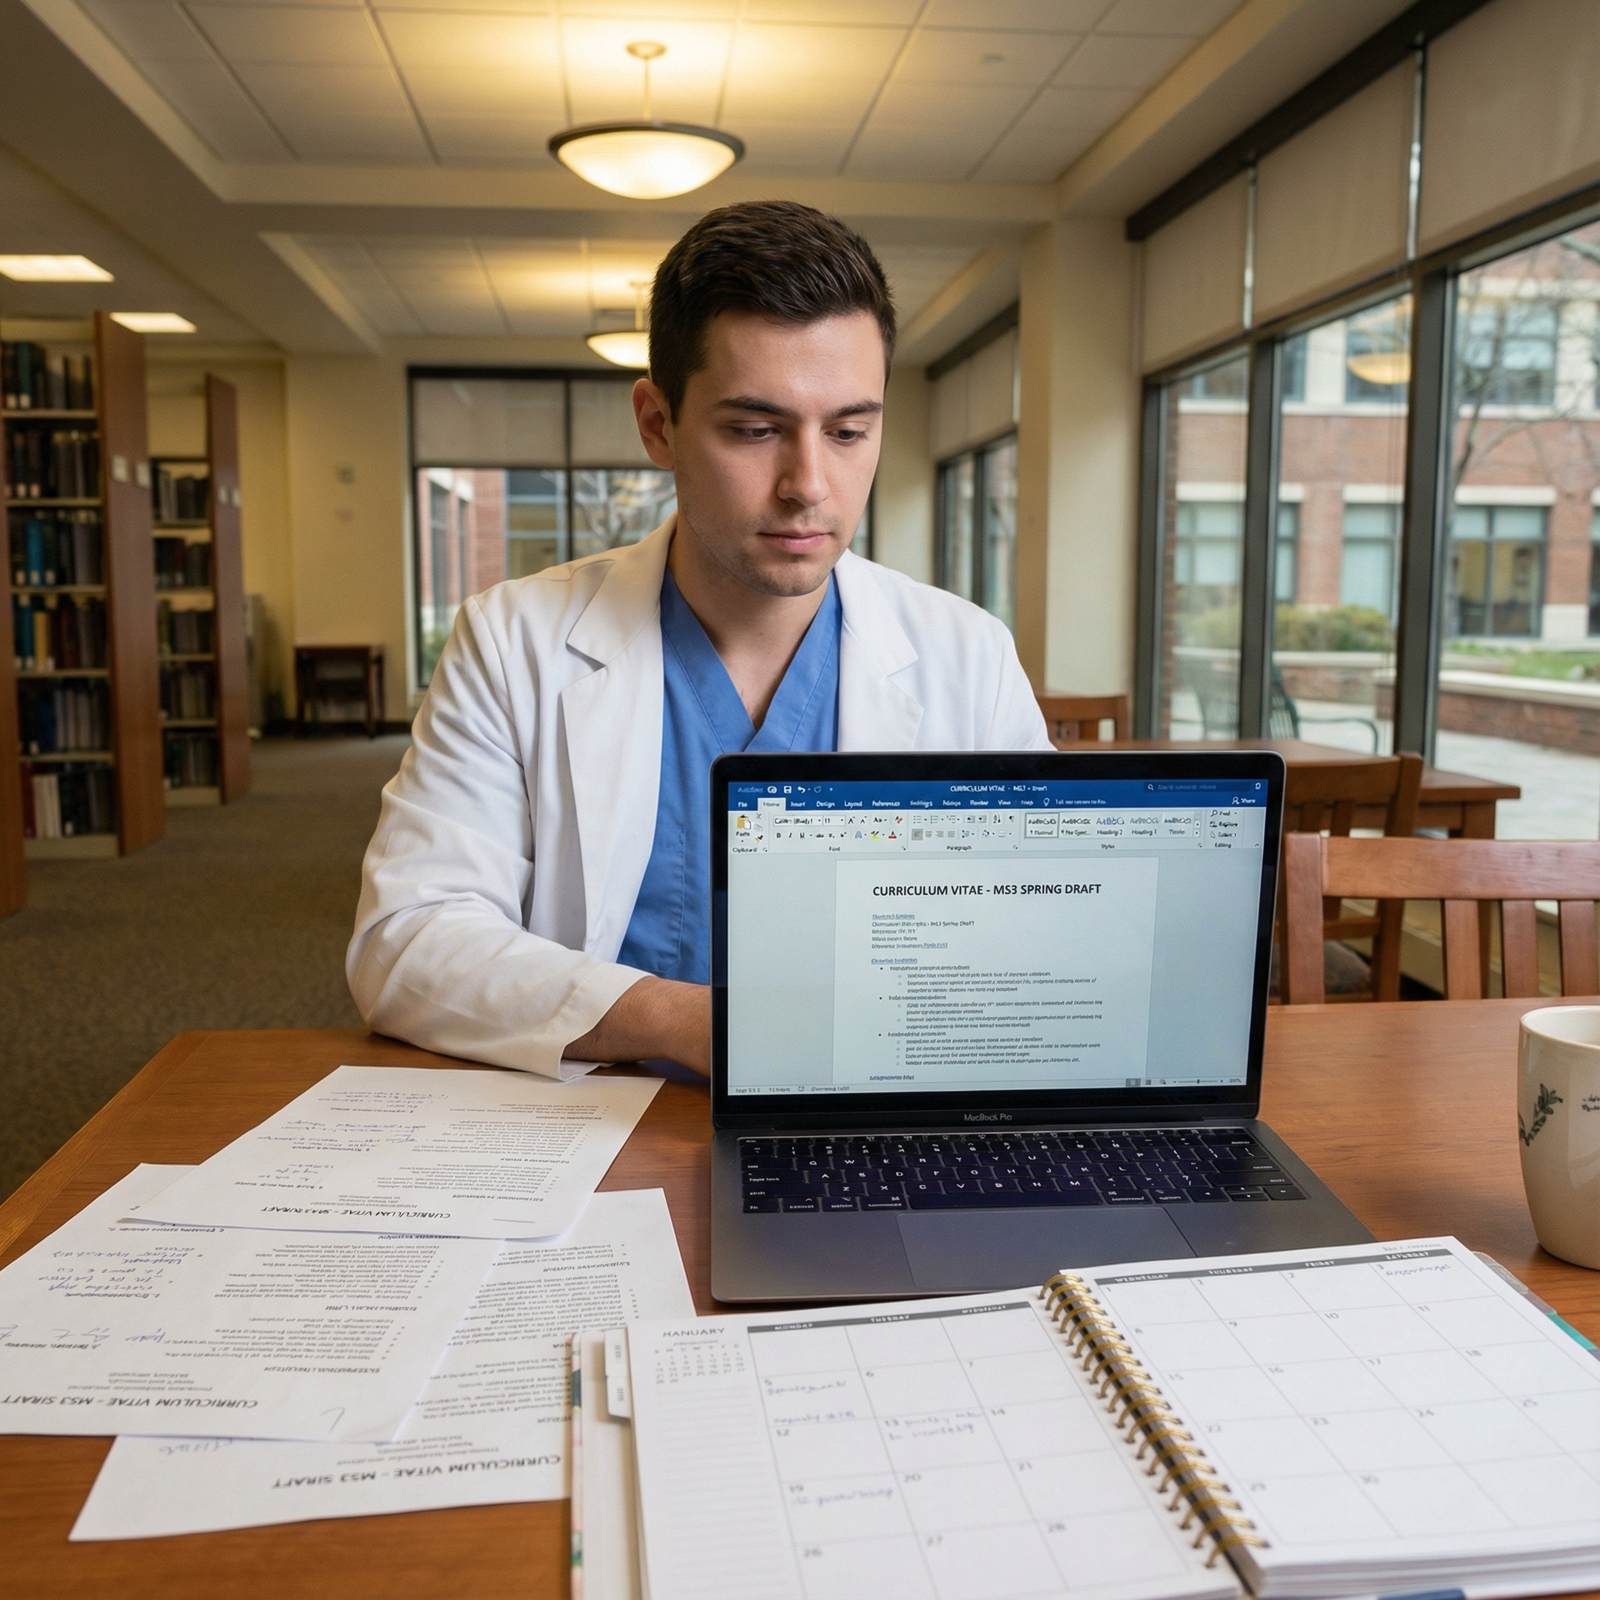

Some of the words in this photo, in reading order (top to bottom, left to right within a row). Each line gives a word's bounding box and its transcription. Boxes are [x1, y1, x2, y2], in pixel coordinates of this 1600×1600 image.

[816, 800, 836, 810] Design
[872, 885, 948, 896] CURRICULUM
[951, 885, 984, 896] VITAE
[993, 885, 1018, 895] MS3
[1020, 884, 1062, 895] SPRING
[1064, 884, 1102, 895] DRAFT
[964, 1112, 998, 1122] MacBook
[999, 1112, 1013, 1121] Pro
[341, 1209, 373, 1217] VITAE
[1229, 1320, 1238, 1329] 9
[1324, 1311, 1340, 1320] 10
[1417, 1304, 1431, 1313] 11
[1168, 1372, 1184, 1382] 15
[1268, 1365, 1284, 1375] 16
[1368, 1357, 1382, 1367] 17
[1465, 1349, 1482, 1358] 18
[108, 1396, 150, 1407] VITAE
[155, 1397, 258, 1409] CURRICULUM
[1417, 1408, 1435, 1419] 24
[775, 1429, 790, 1437] 12
[884, 1419, 900, 1428] 13
[991, 1408, 1006, 1416] 14
[448, 1455, 561, 1474] CURRICULUM
[393, 1466, 443, 1478] VITAE
[904, 1473, 921, 1483] 20
